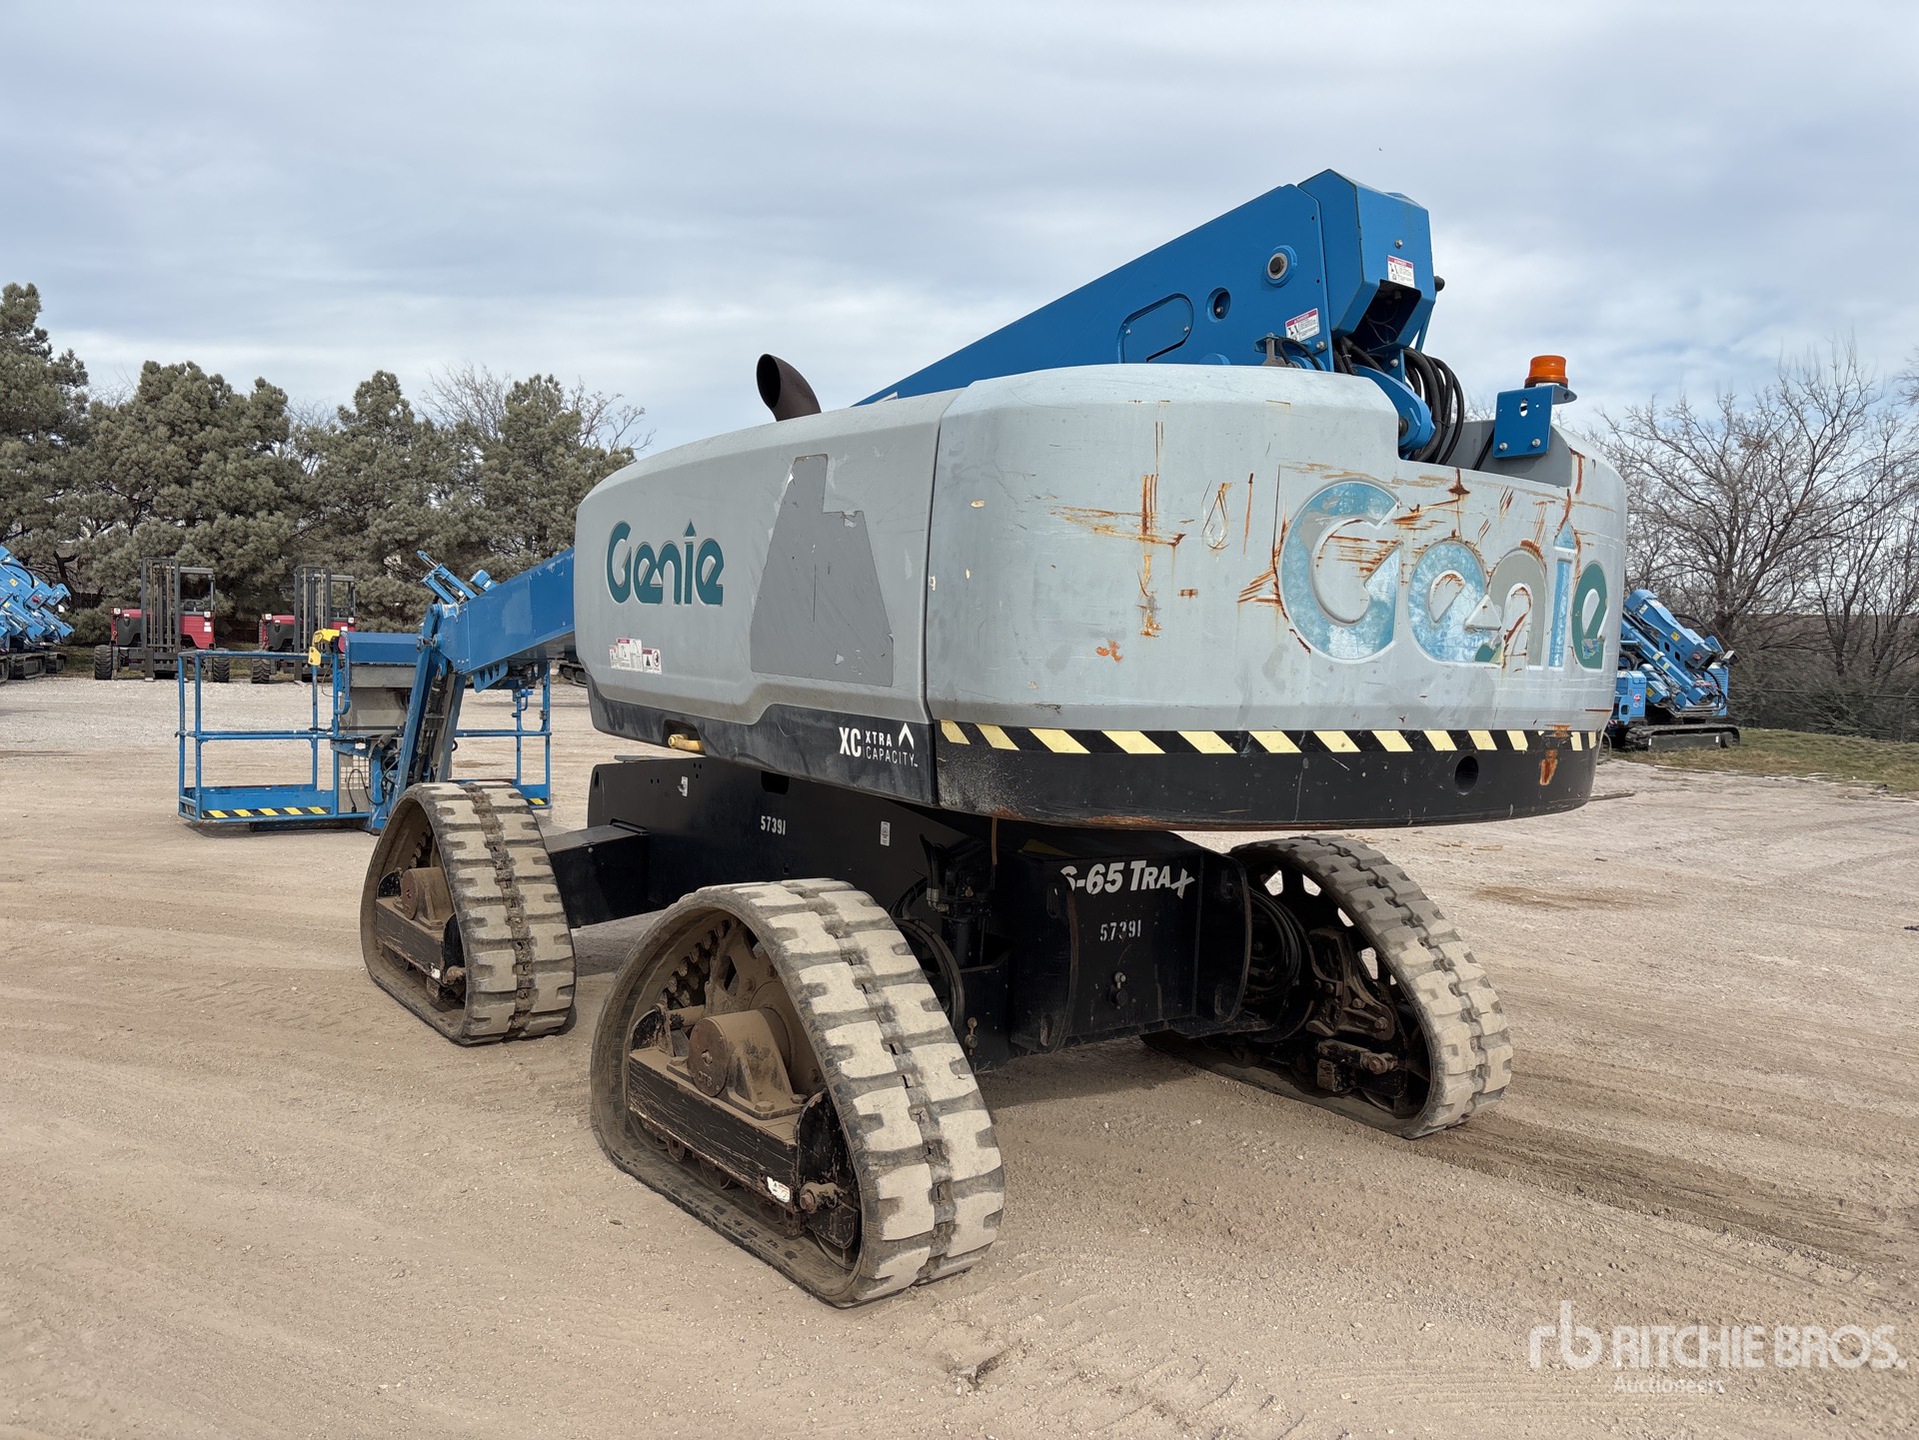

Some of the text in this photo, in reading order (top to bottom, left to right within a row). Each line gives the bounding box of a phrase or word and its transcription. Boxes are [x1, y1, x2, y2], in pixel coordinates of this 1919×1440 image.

[606, 519, 725, 607] Genie
[1279, 477, 1609, 673] Genie
[838, 726, 862, 758] XC
[865, 729, 893, 748] XTRA
[865, 746, 915, 767] CAPACITY
[760, 815, 787, 836] 57391
